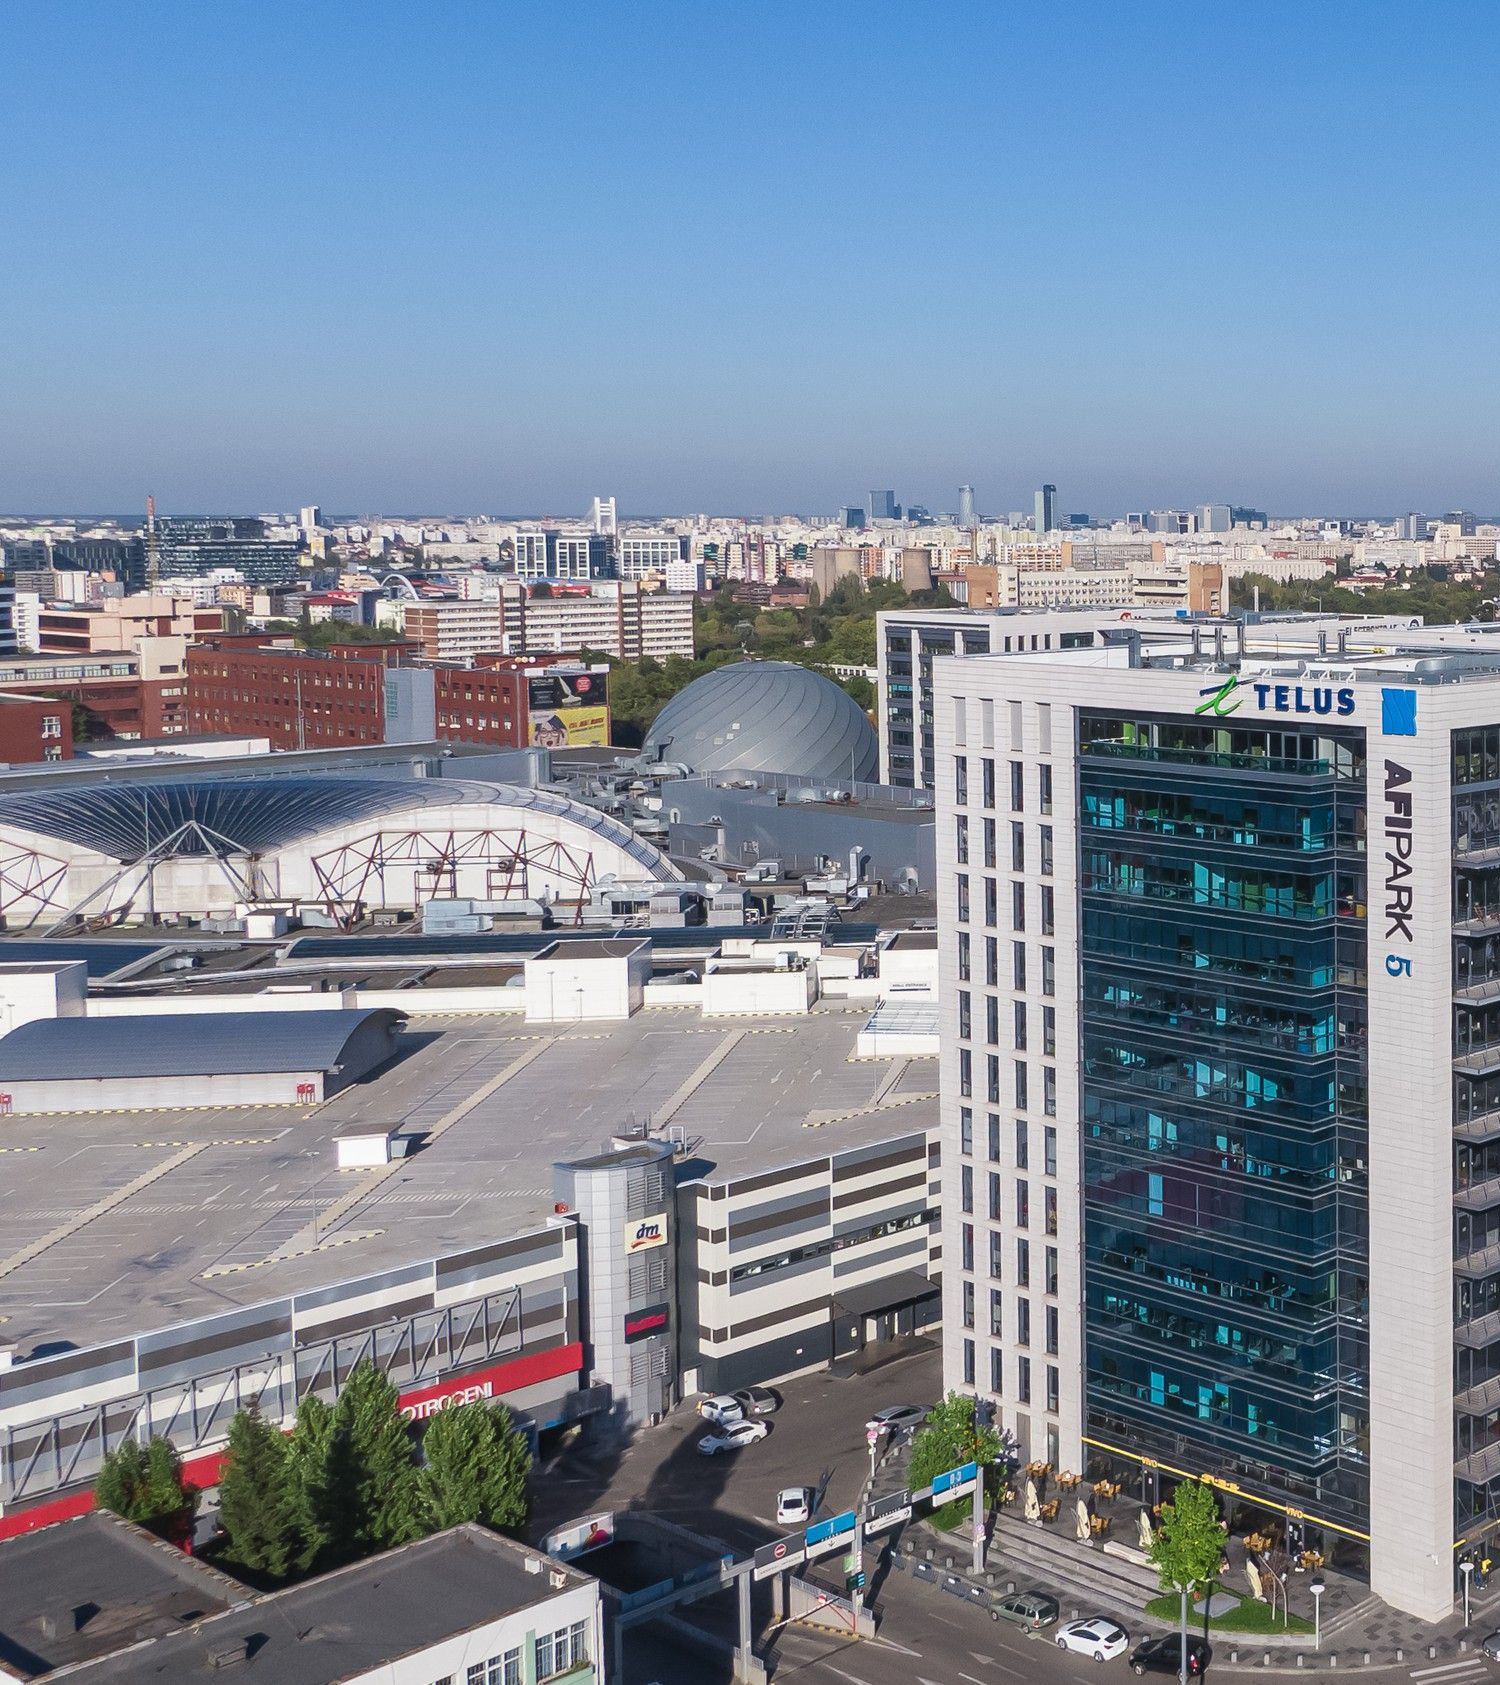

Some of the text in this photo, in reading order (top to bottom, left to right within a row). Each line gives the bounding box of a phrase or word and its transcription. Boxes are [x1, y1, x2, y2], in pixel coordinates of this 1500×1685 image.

[1253, 684, 1355, 716] TELUS
[1384, 758, 1413, 977] AFIPARK 5
[636, 1223, 659, 1239] dm
